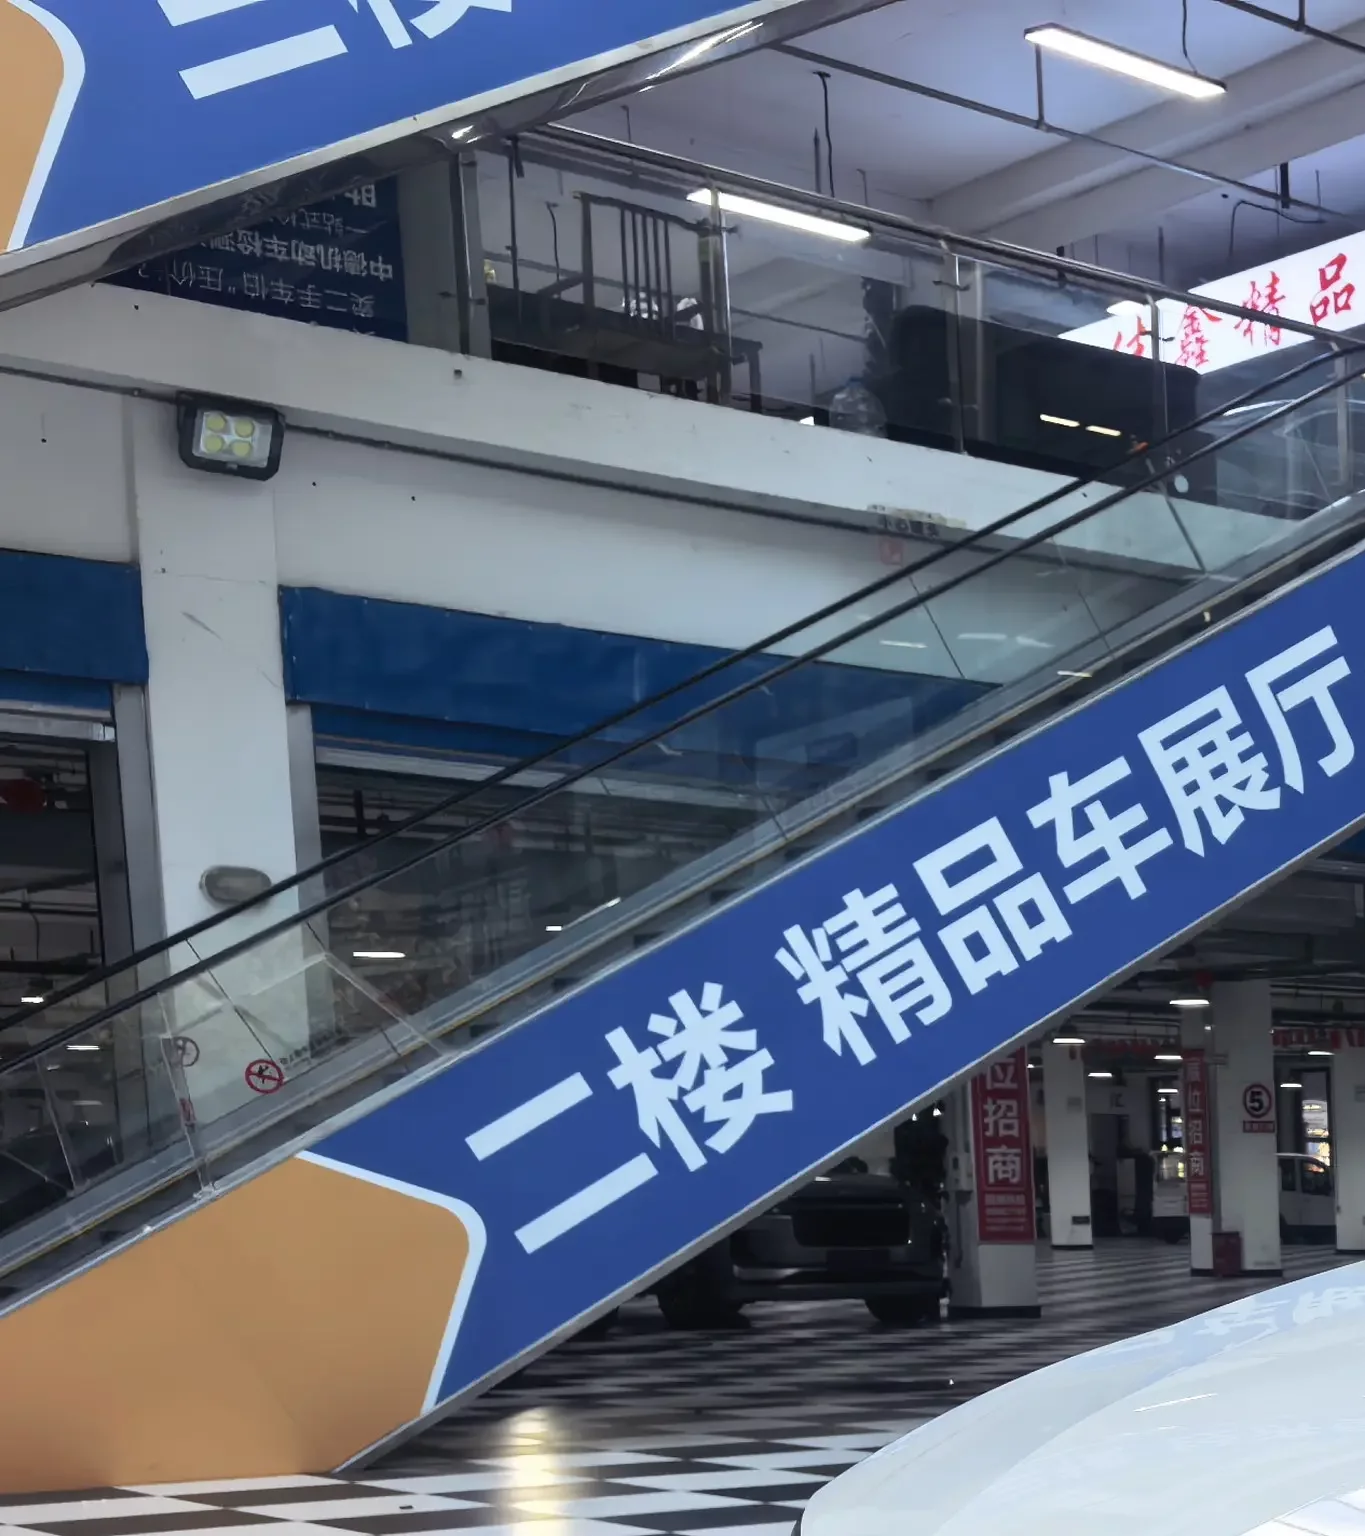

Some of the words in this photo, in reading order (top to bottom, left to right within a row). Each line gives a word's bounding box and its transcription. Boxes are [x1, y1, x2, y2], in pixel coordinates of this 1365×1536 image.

[464, 982, 795, 1255] 二楼
[775, 624, 1356, 1066] 精品车展厅
[1248, 1090, 1264, 1112] 5
